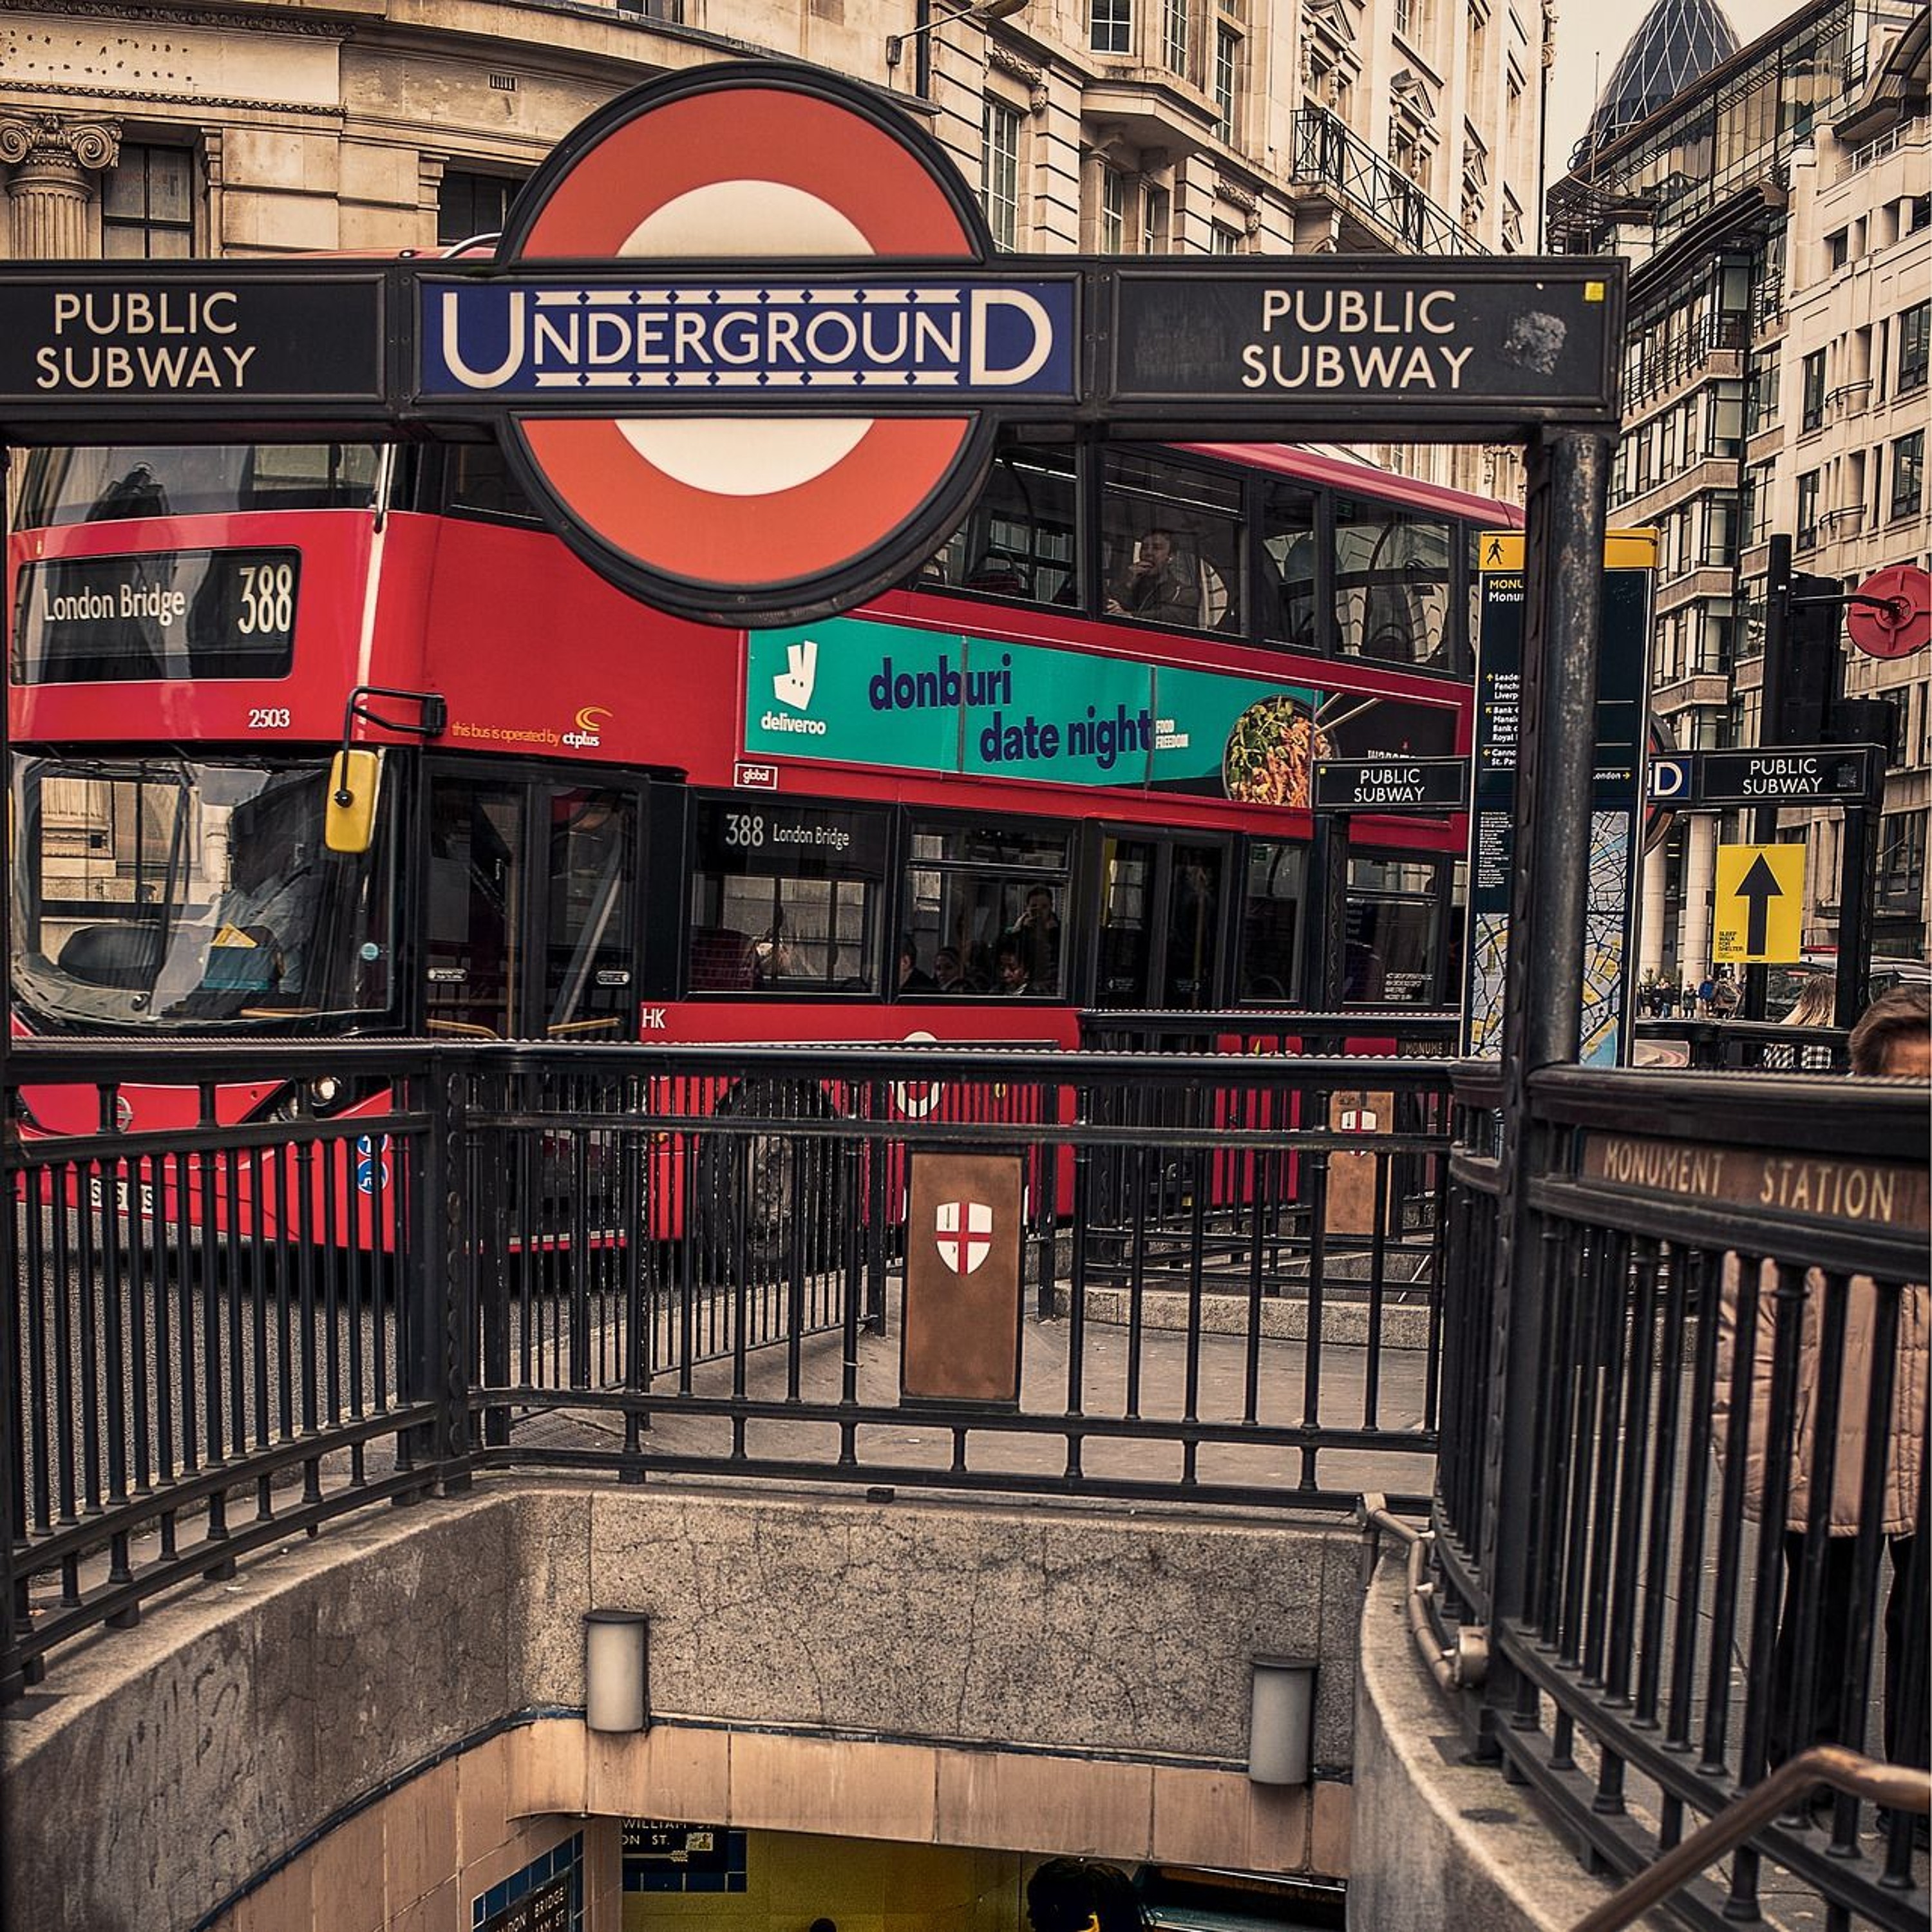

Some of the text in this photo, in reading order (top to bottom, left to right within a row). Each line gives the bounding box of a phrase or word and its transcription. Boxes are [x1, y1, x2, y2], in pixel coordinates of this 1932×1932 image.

[55, 292, 238, 334] PUBLIC
[1262, 290, 1457, 334] PUBLIC
[442, 289, 1052, 390] UNDERGROUND
[36, 346, 256, 388] SUBWAY
[1241, 345, 1474, 388] SUBWAY
[43, 583, 185, 627] London Bridge
[238, 564, 294, 634] 388
[869, 653, 1012, 711] donburi
[248, 708, 290, 728] 2503
[471, 723, 490, 738] bus
[501, 727, 546, 744] operated
[761, 711, 827, 736] deliveroo
[979, 704, 1153, 770] date night
[1360, 768, 1421, 784] PUBLIC
[1592, 771, 1621, 780] ondon
[1750, 758, 1817, 775] PUBLIC
[1354, 786, 1425, 802] SUBWAY
[1743, 777, 1823, 795] SUBWAY
[725, 813, 849, 851] 388 London Bridge
[642, 1008, 666, 1029] HK
[1603, 1141, 1895, 1222] MONUMENT STATION
[652, 1835, 670, 1845] ST.
[534, 1886, 565, 1918] BRIDGE
